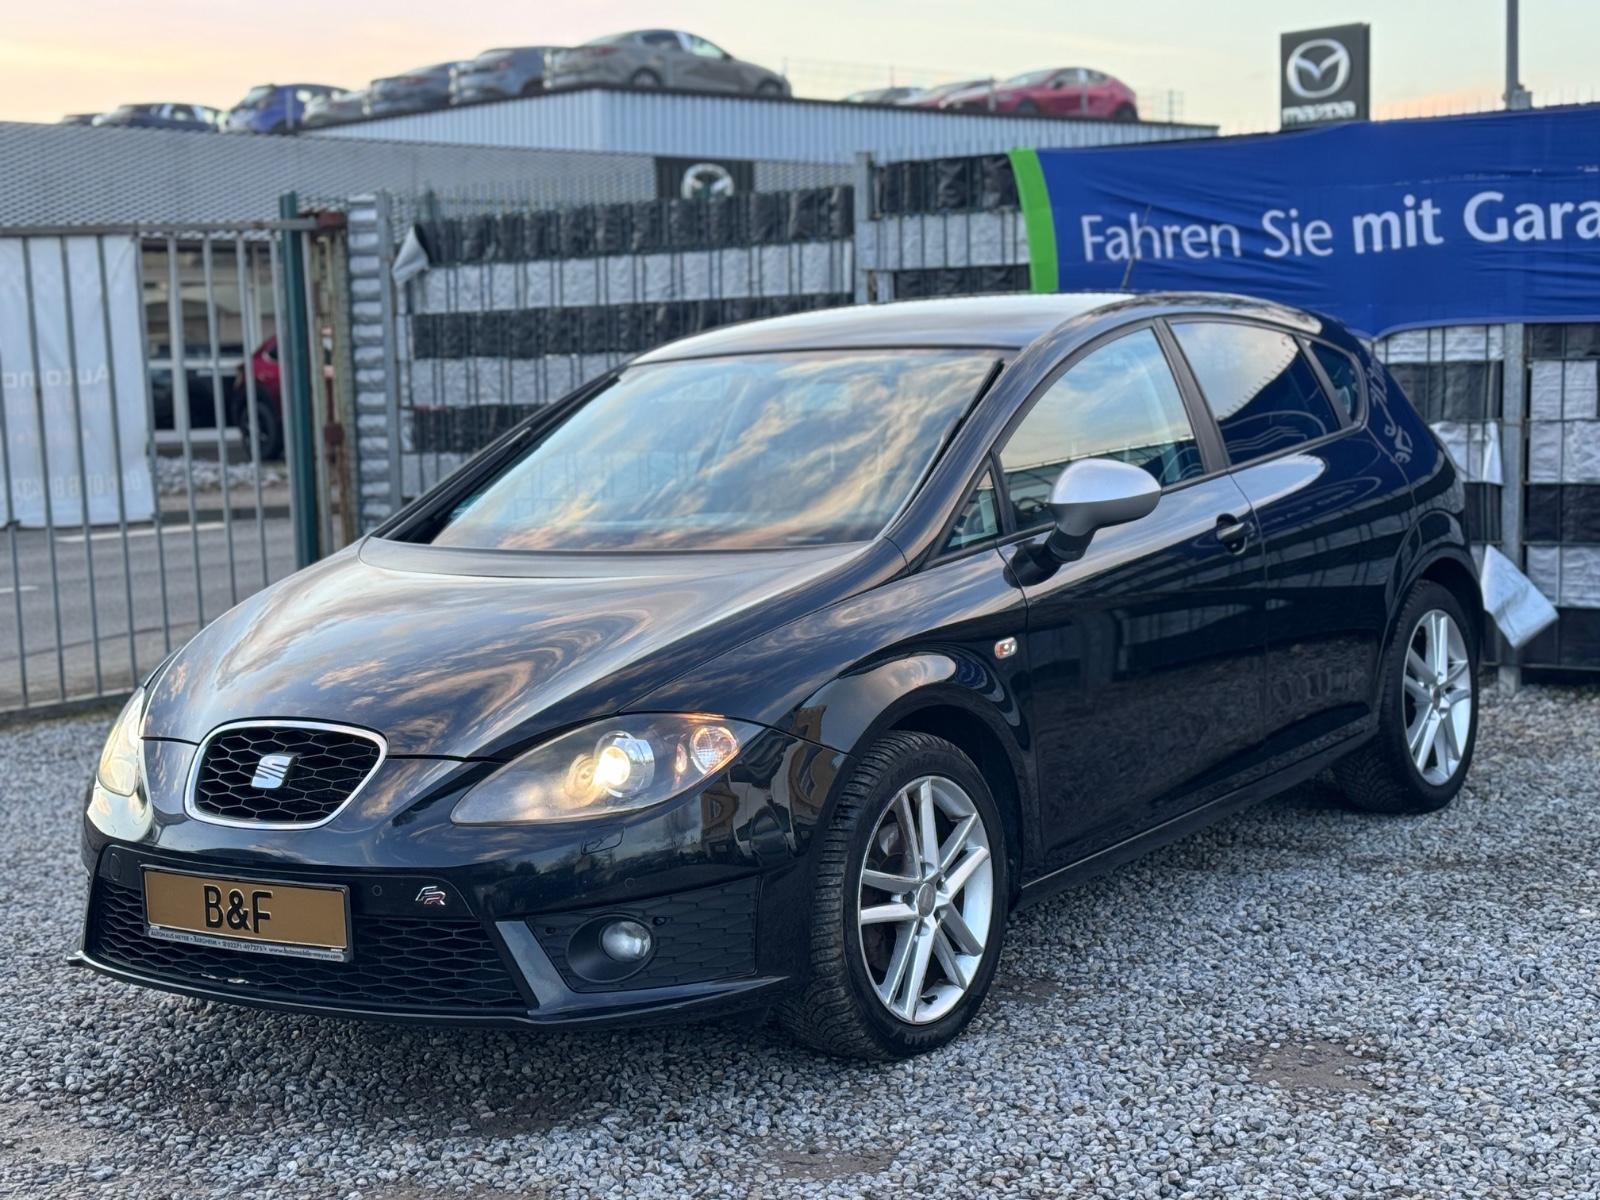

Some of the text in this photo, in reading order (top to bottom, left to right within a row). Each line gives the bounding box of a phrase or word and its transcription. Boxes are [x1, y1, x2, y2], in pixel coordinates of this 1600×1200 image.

[1081, 212, 1242, 262] Fahren
[1262, 208, 1334, 258] Sie
[1352, 194, 1445, 254] mit
[203, 884, 273, 934] B&F
